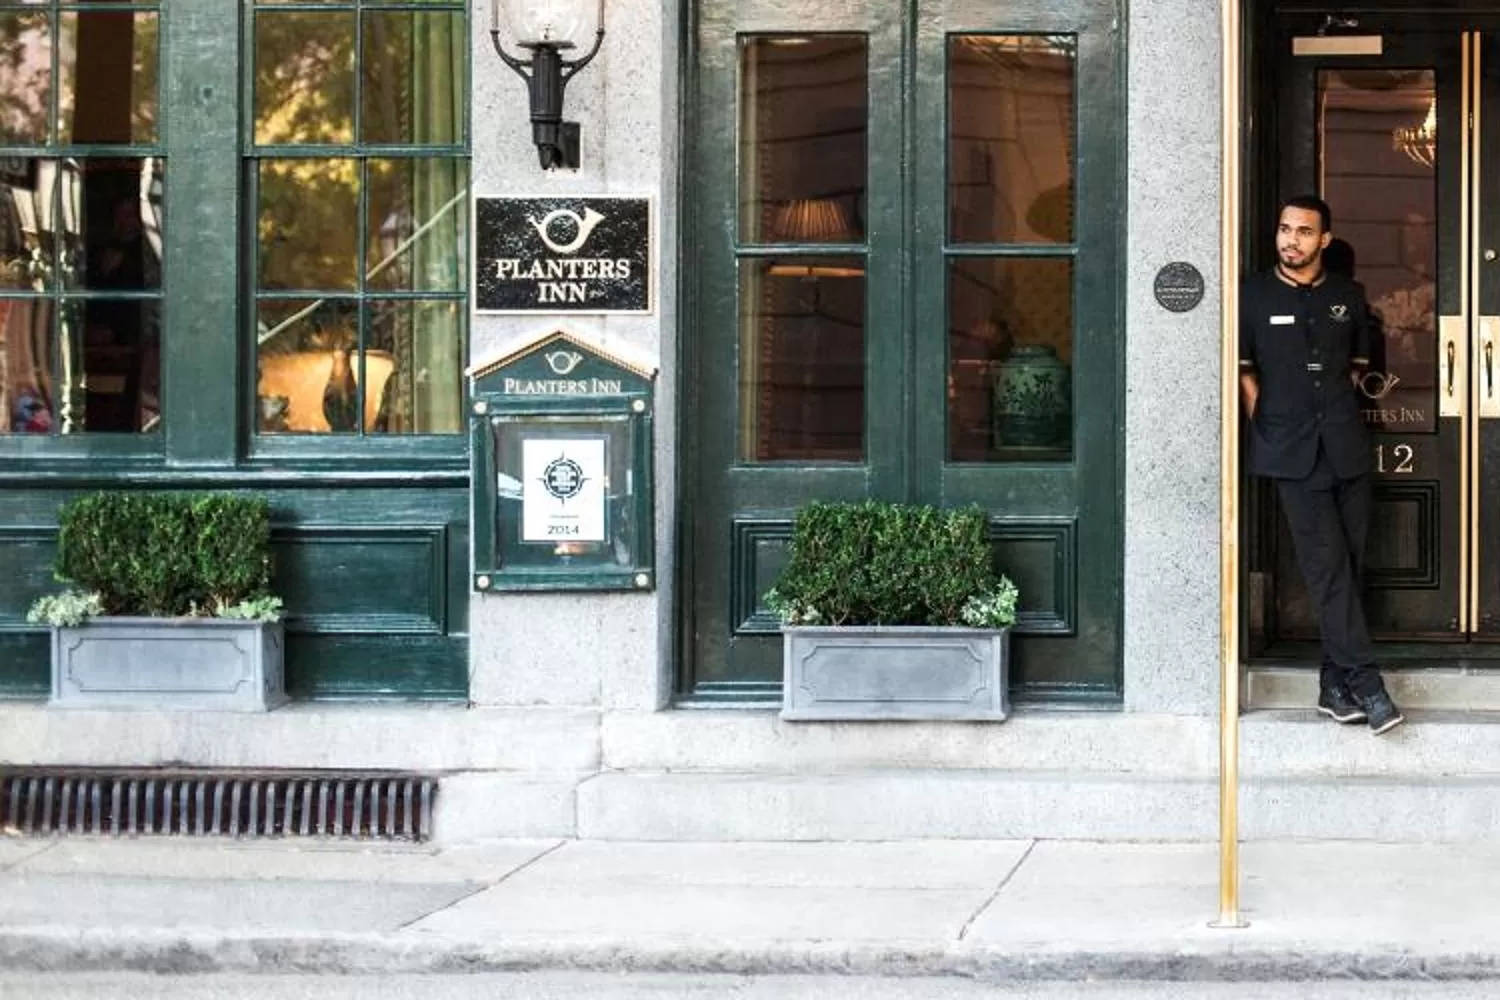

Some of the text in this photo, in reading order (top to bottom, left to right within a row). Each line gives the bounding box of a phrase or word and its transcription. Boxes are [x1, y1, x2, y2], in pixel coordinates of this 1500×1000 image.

[495, 258, 632, 281] PLANTERS
[537, 281, 588, 304] INN
[547, 524, 580, 536] 2014
